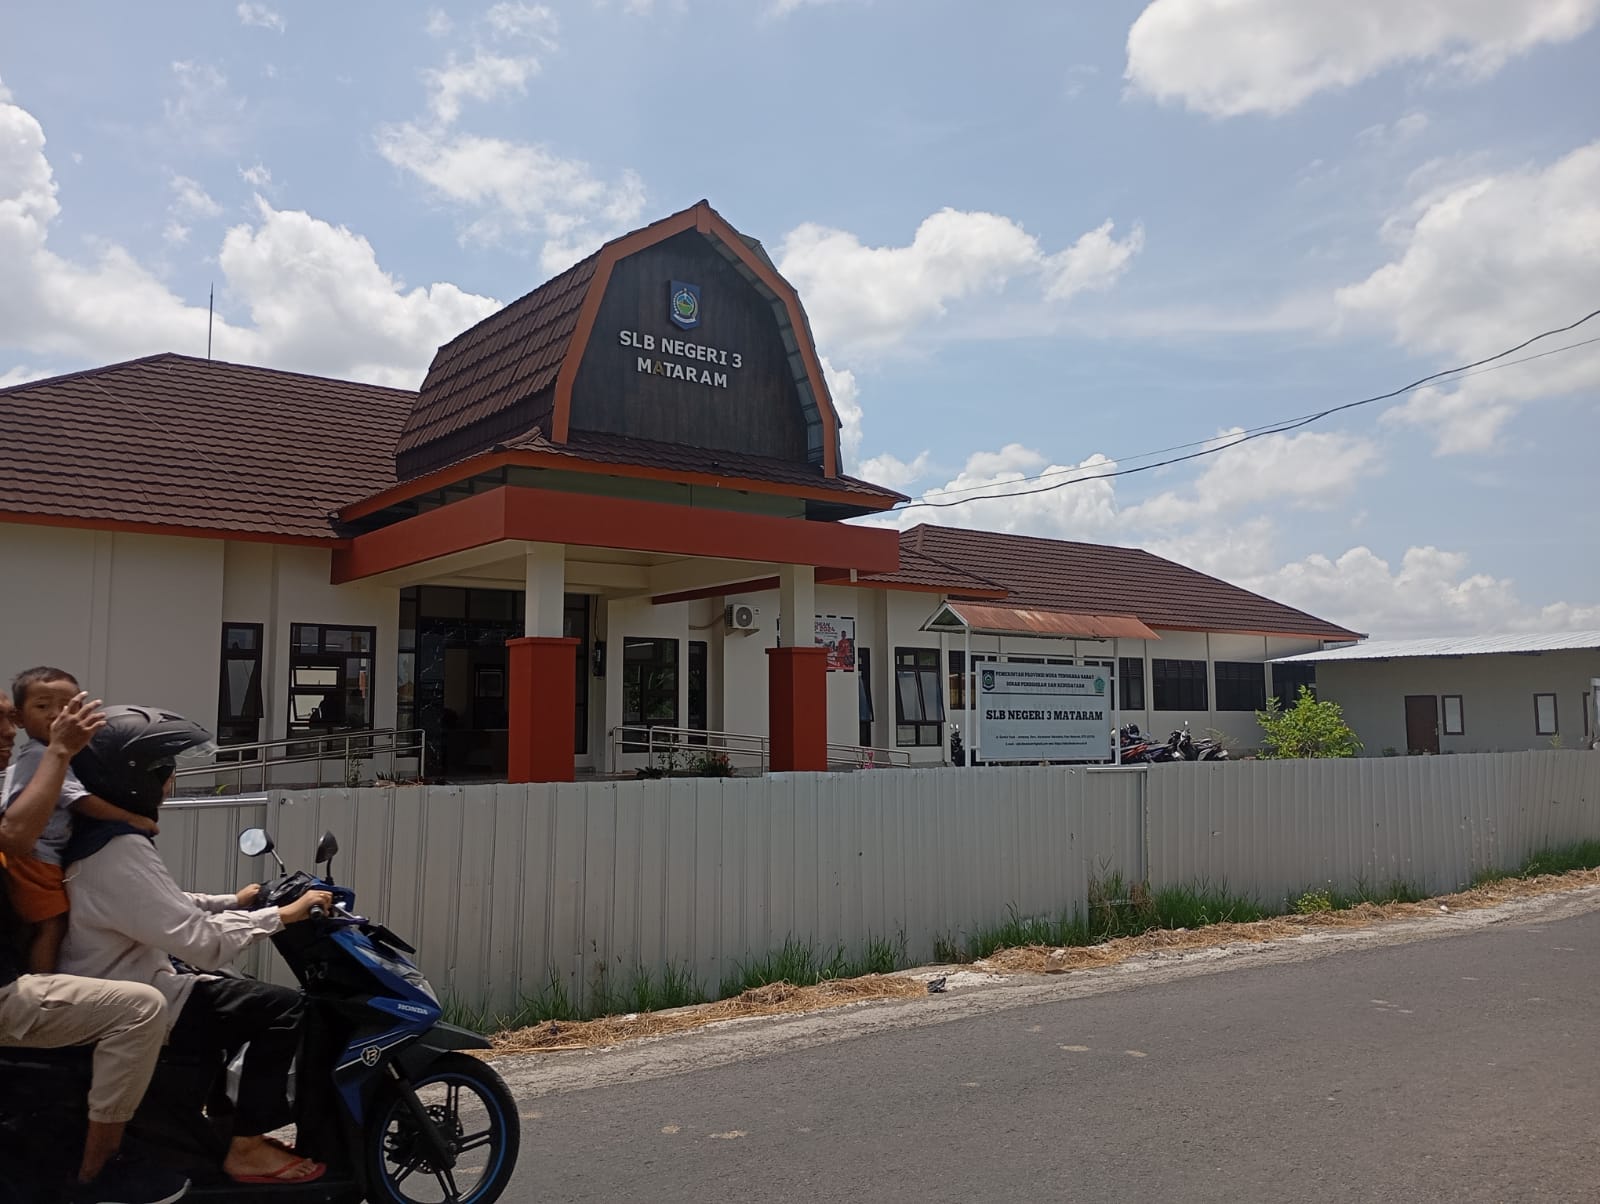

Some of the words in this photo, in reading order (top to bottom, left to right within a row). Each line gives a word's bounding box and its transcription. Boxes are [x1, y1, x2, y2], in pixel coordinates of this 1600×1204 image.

[619, 330, 655, 350] SLB
[661, 338, 728, 365] NEGERI
[732, 353, 742, 368] 3
[637, 357, 728, 388] MATARAM
[985, 709, 1006, 720] SLB
[1007, 710, 1045, 720] NEGERI
[1046, 710, 1052, 720] 3
[1053, 710, 1103, 721] MATARAM
[397, 1003, 428, 1015] HONDA
